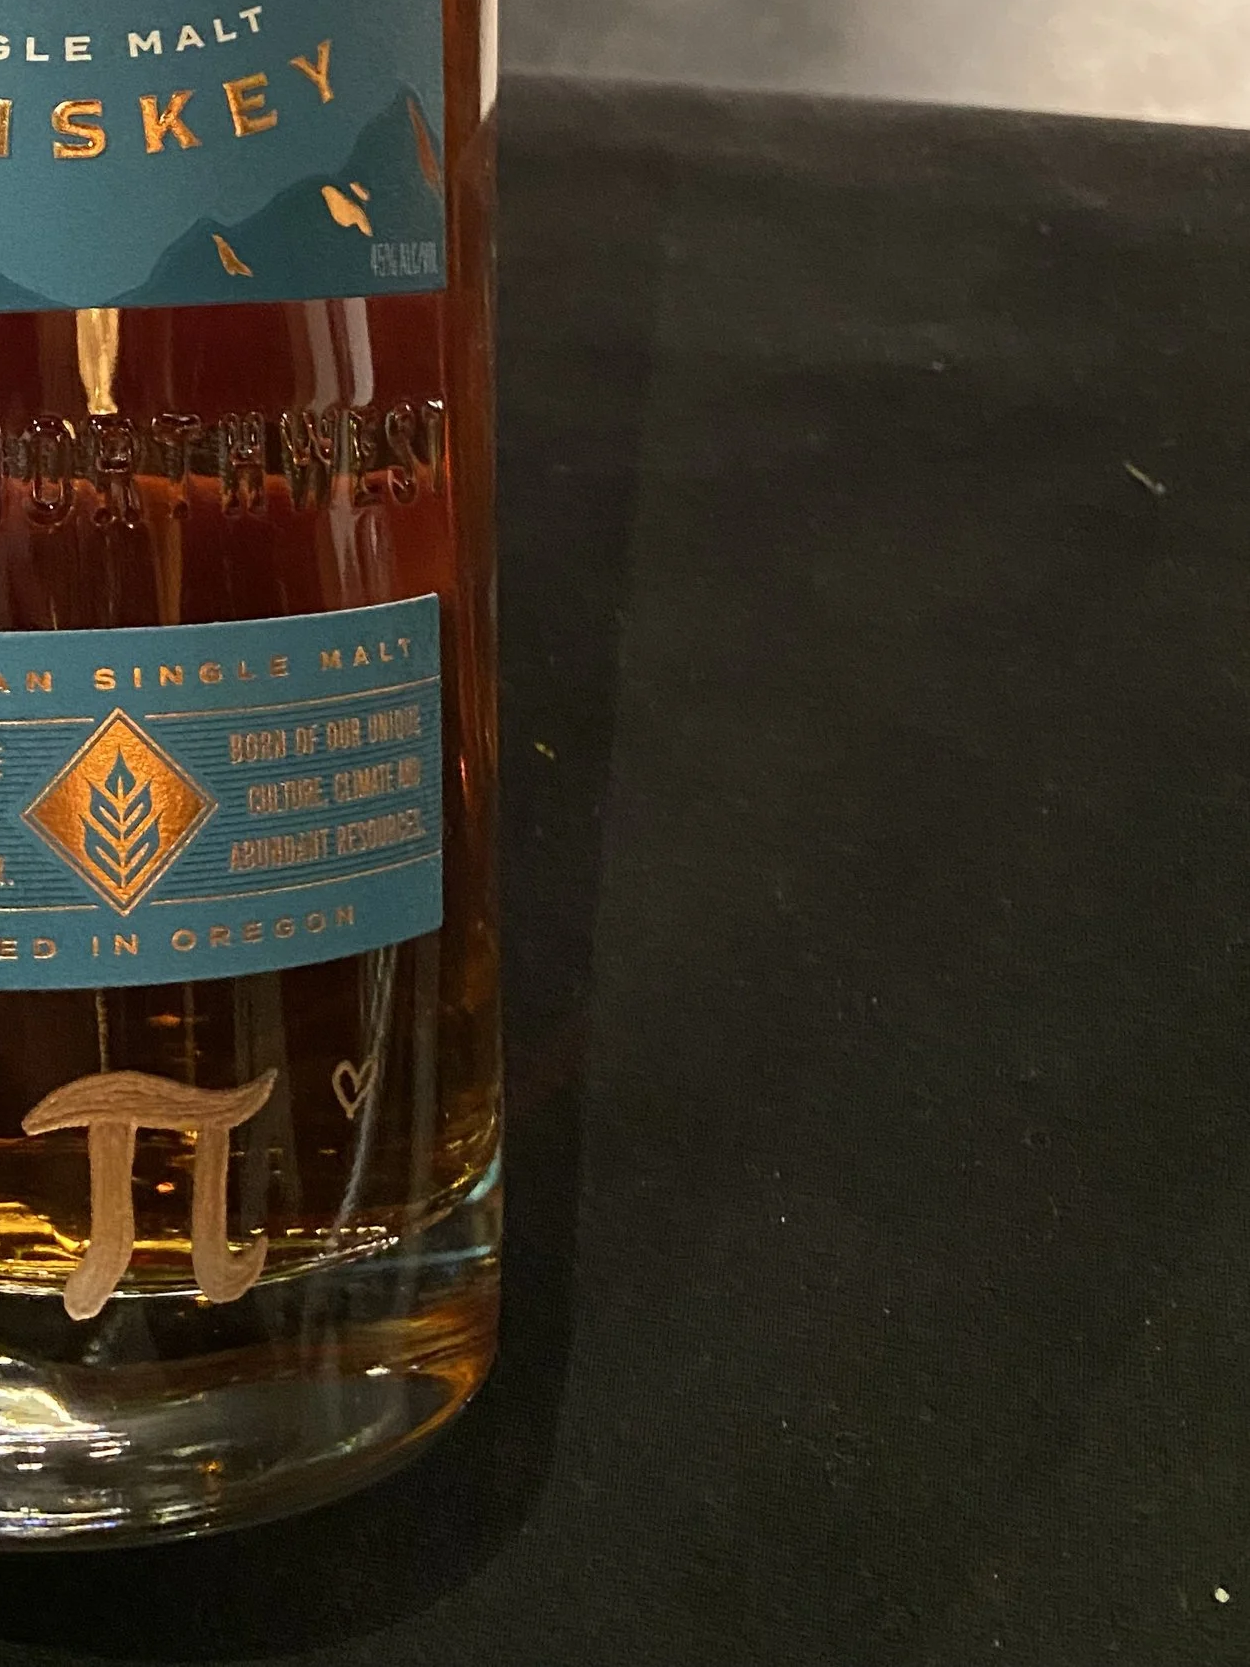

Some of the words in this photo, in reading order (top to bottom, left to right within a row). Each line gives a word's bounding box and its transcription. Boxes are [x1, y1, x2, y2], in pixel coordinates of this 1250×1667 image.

[128, 5, 263, 58] MALT
[94, 654, 290, 692] SINGLE
[320, 637, 412, 671] MALT
[296, 724, 319, 755] OF
[326, 718, 361, 751] OUR
[91, 933, 139, 958] IN
[170, 905, 355, 952] OREGON
